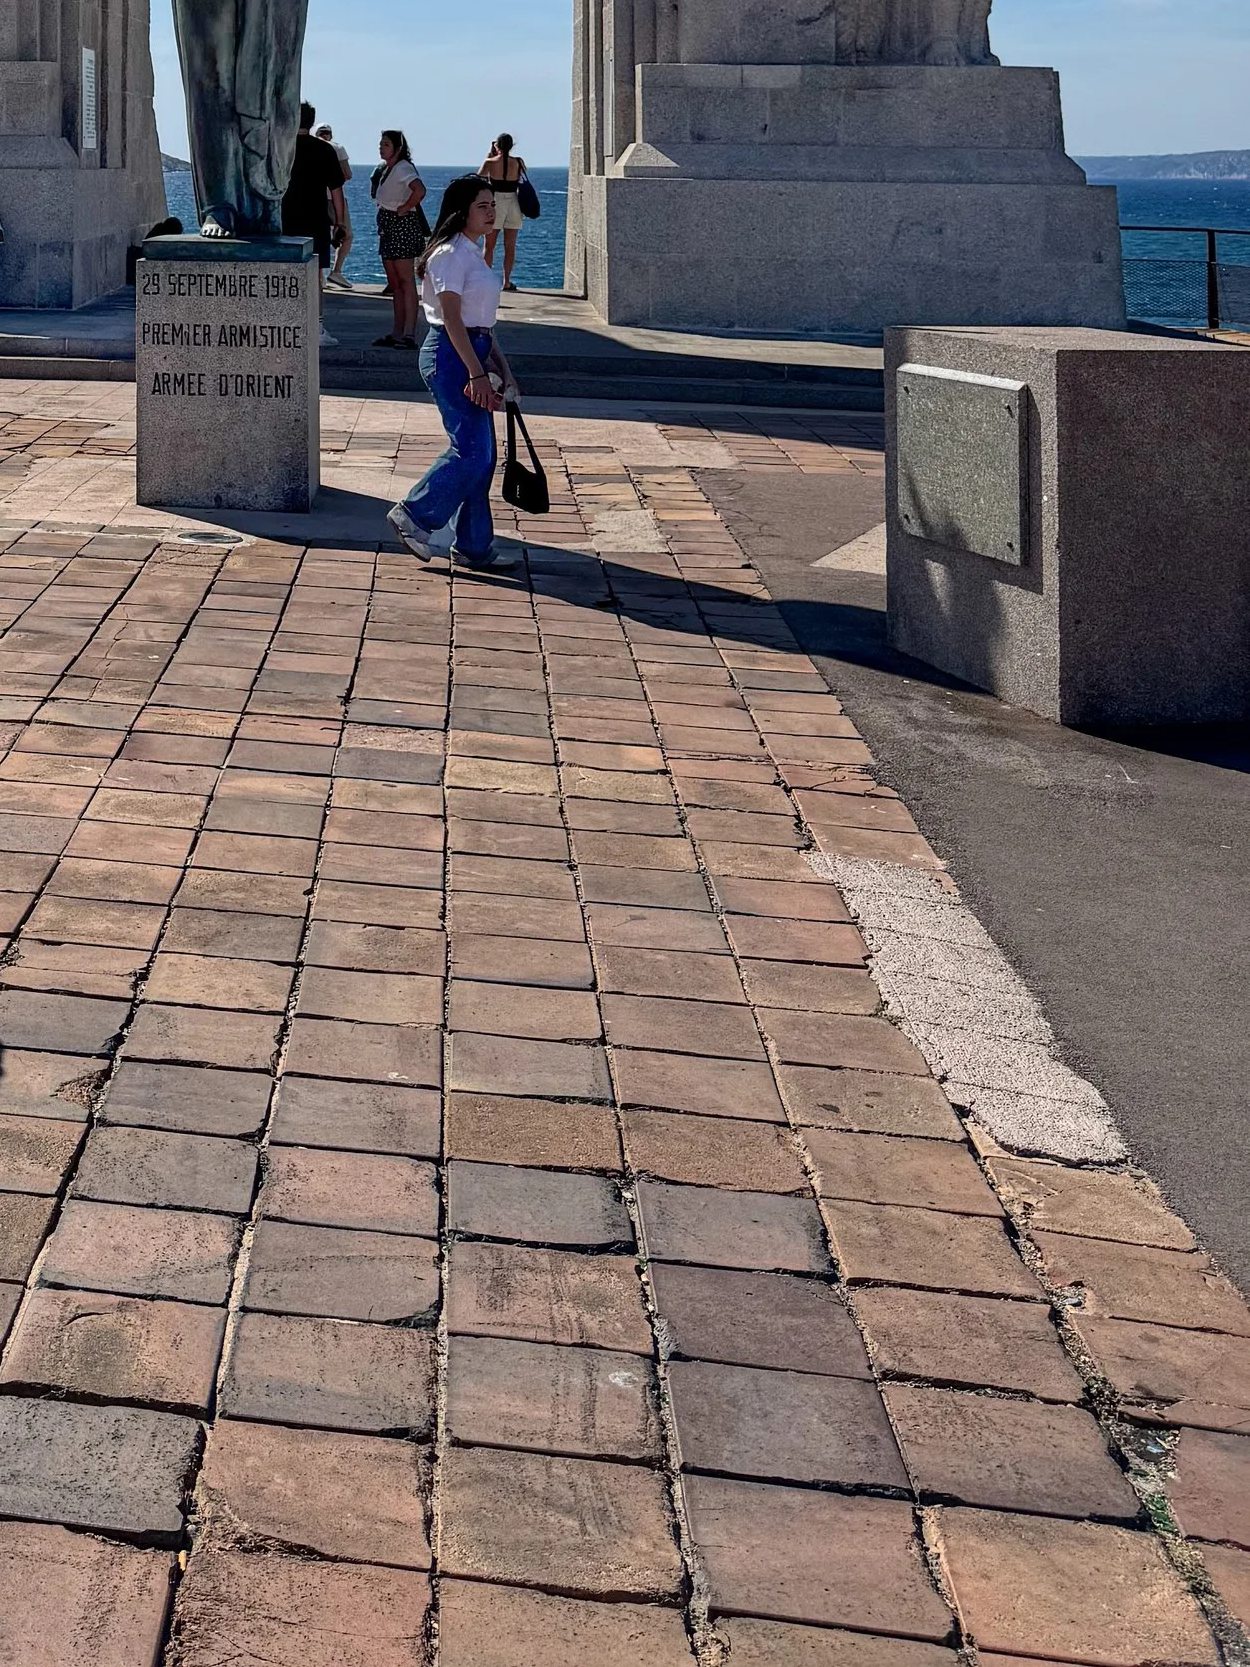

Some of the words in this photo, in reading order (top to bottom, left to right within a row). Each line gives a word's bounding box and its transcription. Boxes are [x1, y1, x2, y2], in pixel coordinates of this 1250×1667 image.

[142, 273, 160, 296] 29
[168, 273, 259, 298] SEPTEMBRE
[264, 274, 300, 299] 1918
[142, 322, 212, 347] PREMIER
[217, 324, 302, 349] ARMISTICE
[151, 371, 207, 397] ARMEE
[219, 373, 294, 399] D'ORIENT
